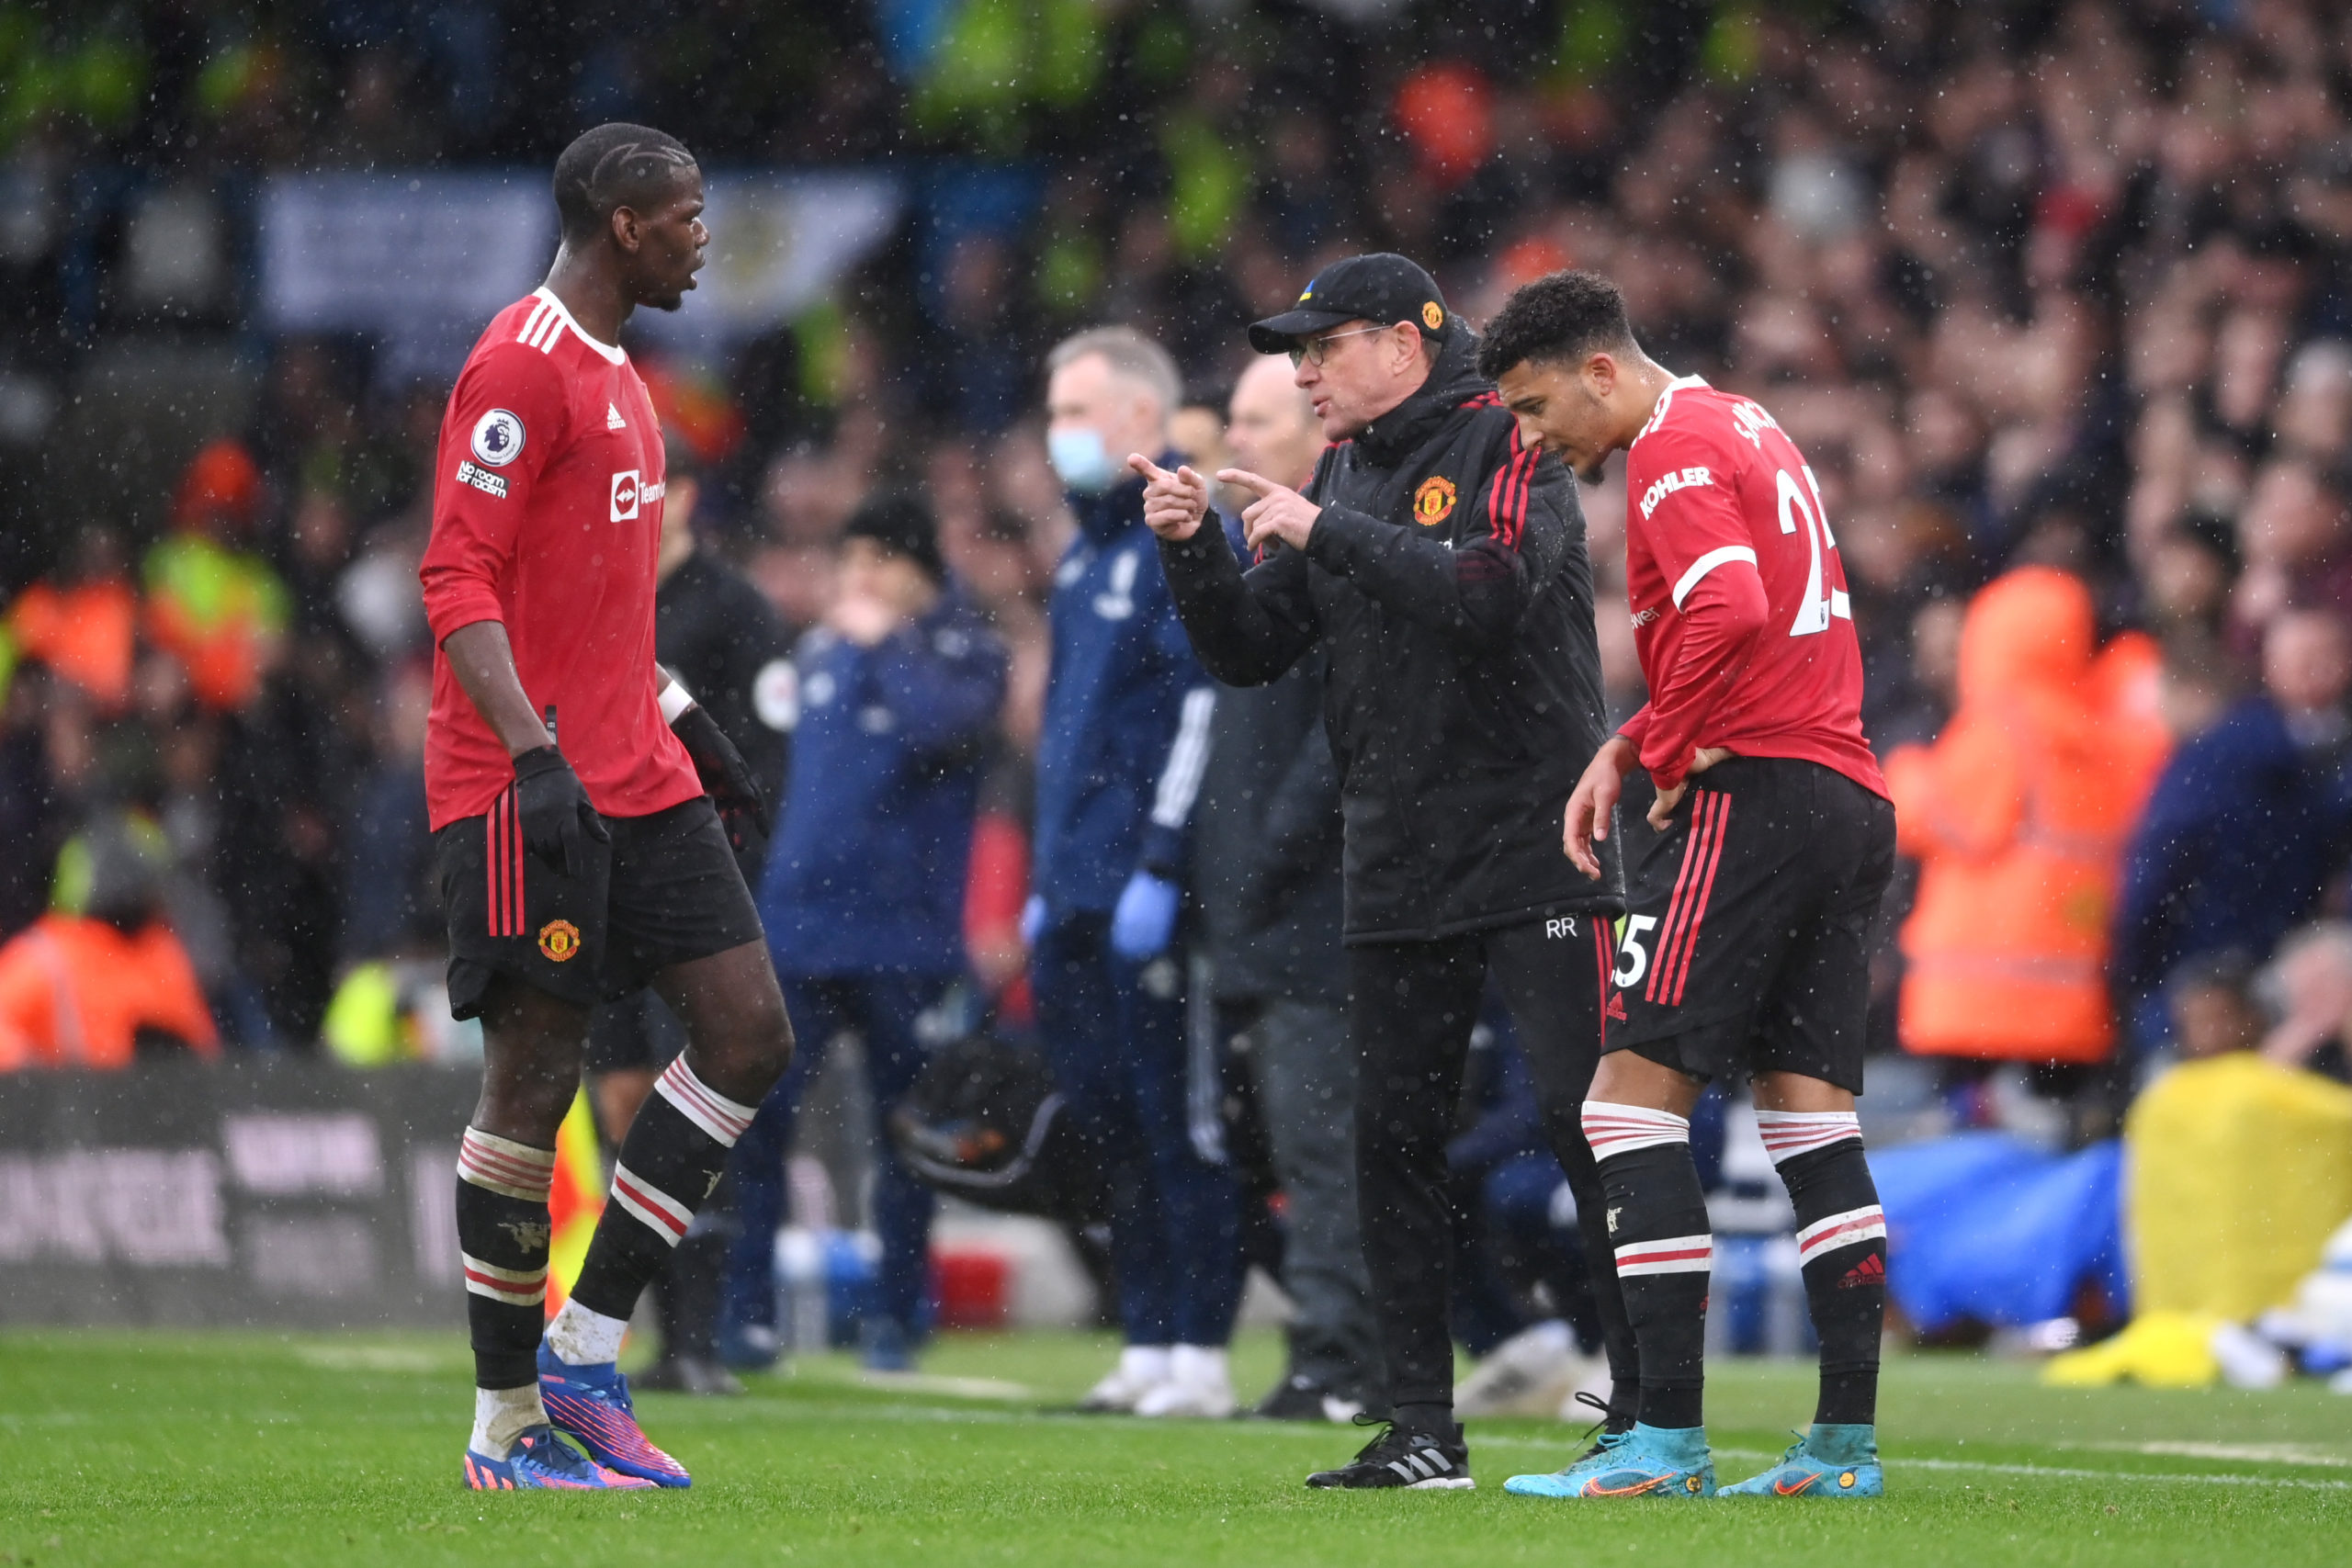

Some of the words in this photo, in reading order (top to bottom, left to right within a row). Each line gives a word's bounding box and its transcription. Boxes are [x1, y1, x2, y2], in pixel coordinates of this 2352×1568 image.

[456, 470, 472, 484] for
[470, 477, 507, 500] racism
[458, 459, 476, 474] No
[474, 468, 505, 488] room
[1639, 466, 1714, 520] KOHLER
[1629, 606, 1661, 630] wer
[1546, 917, 1577, 940] RR
[1611, 914, 1658, 987] 5
